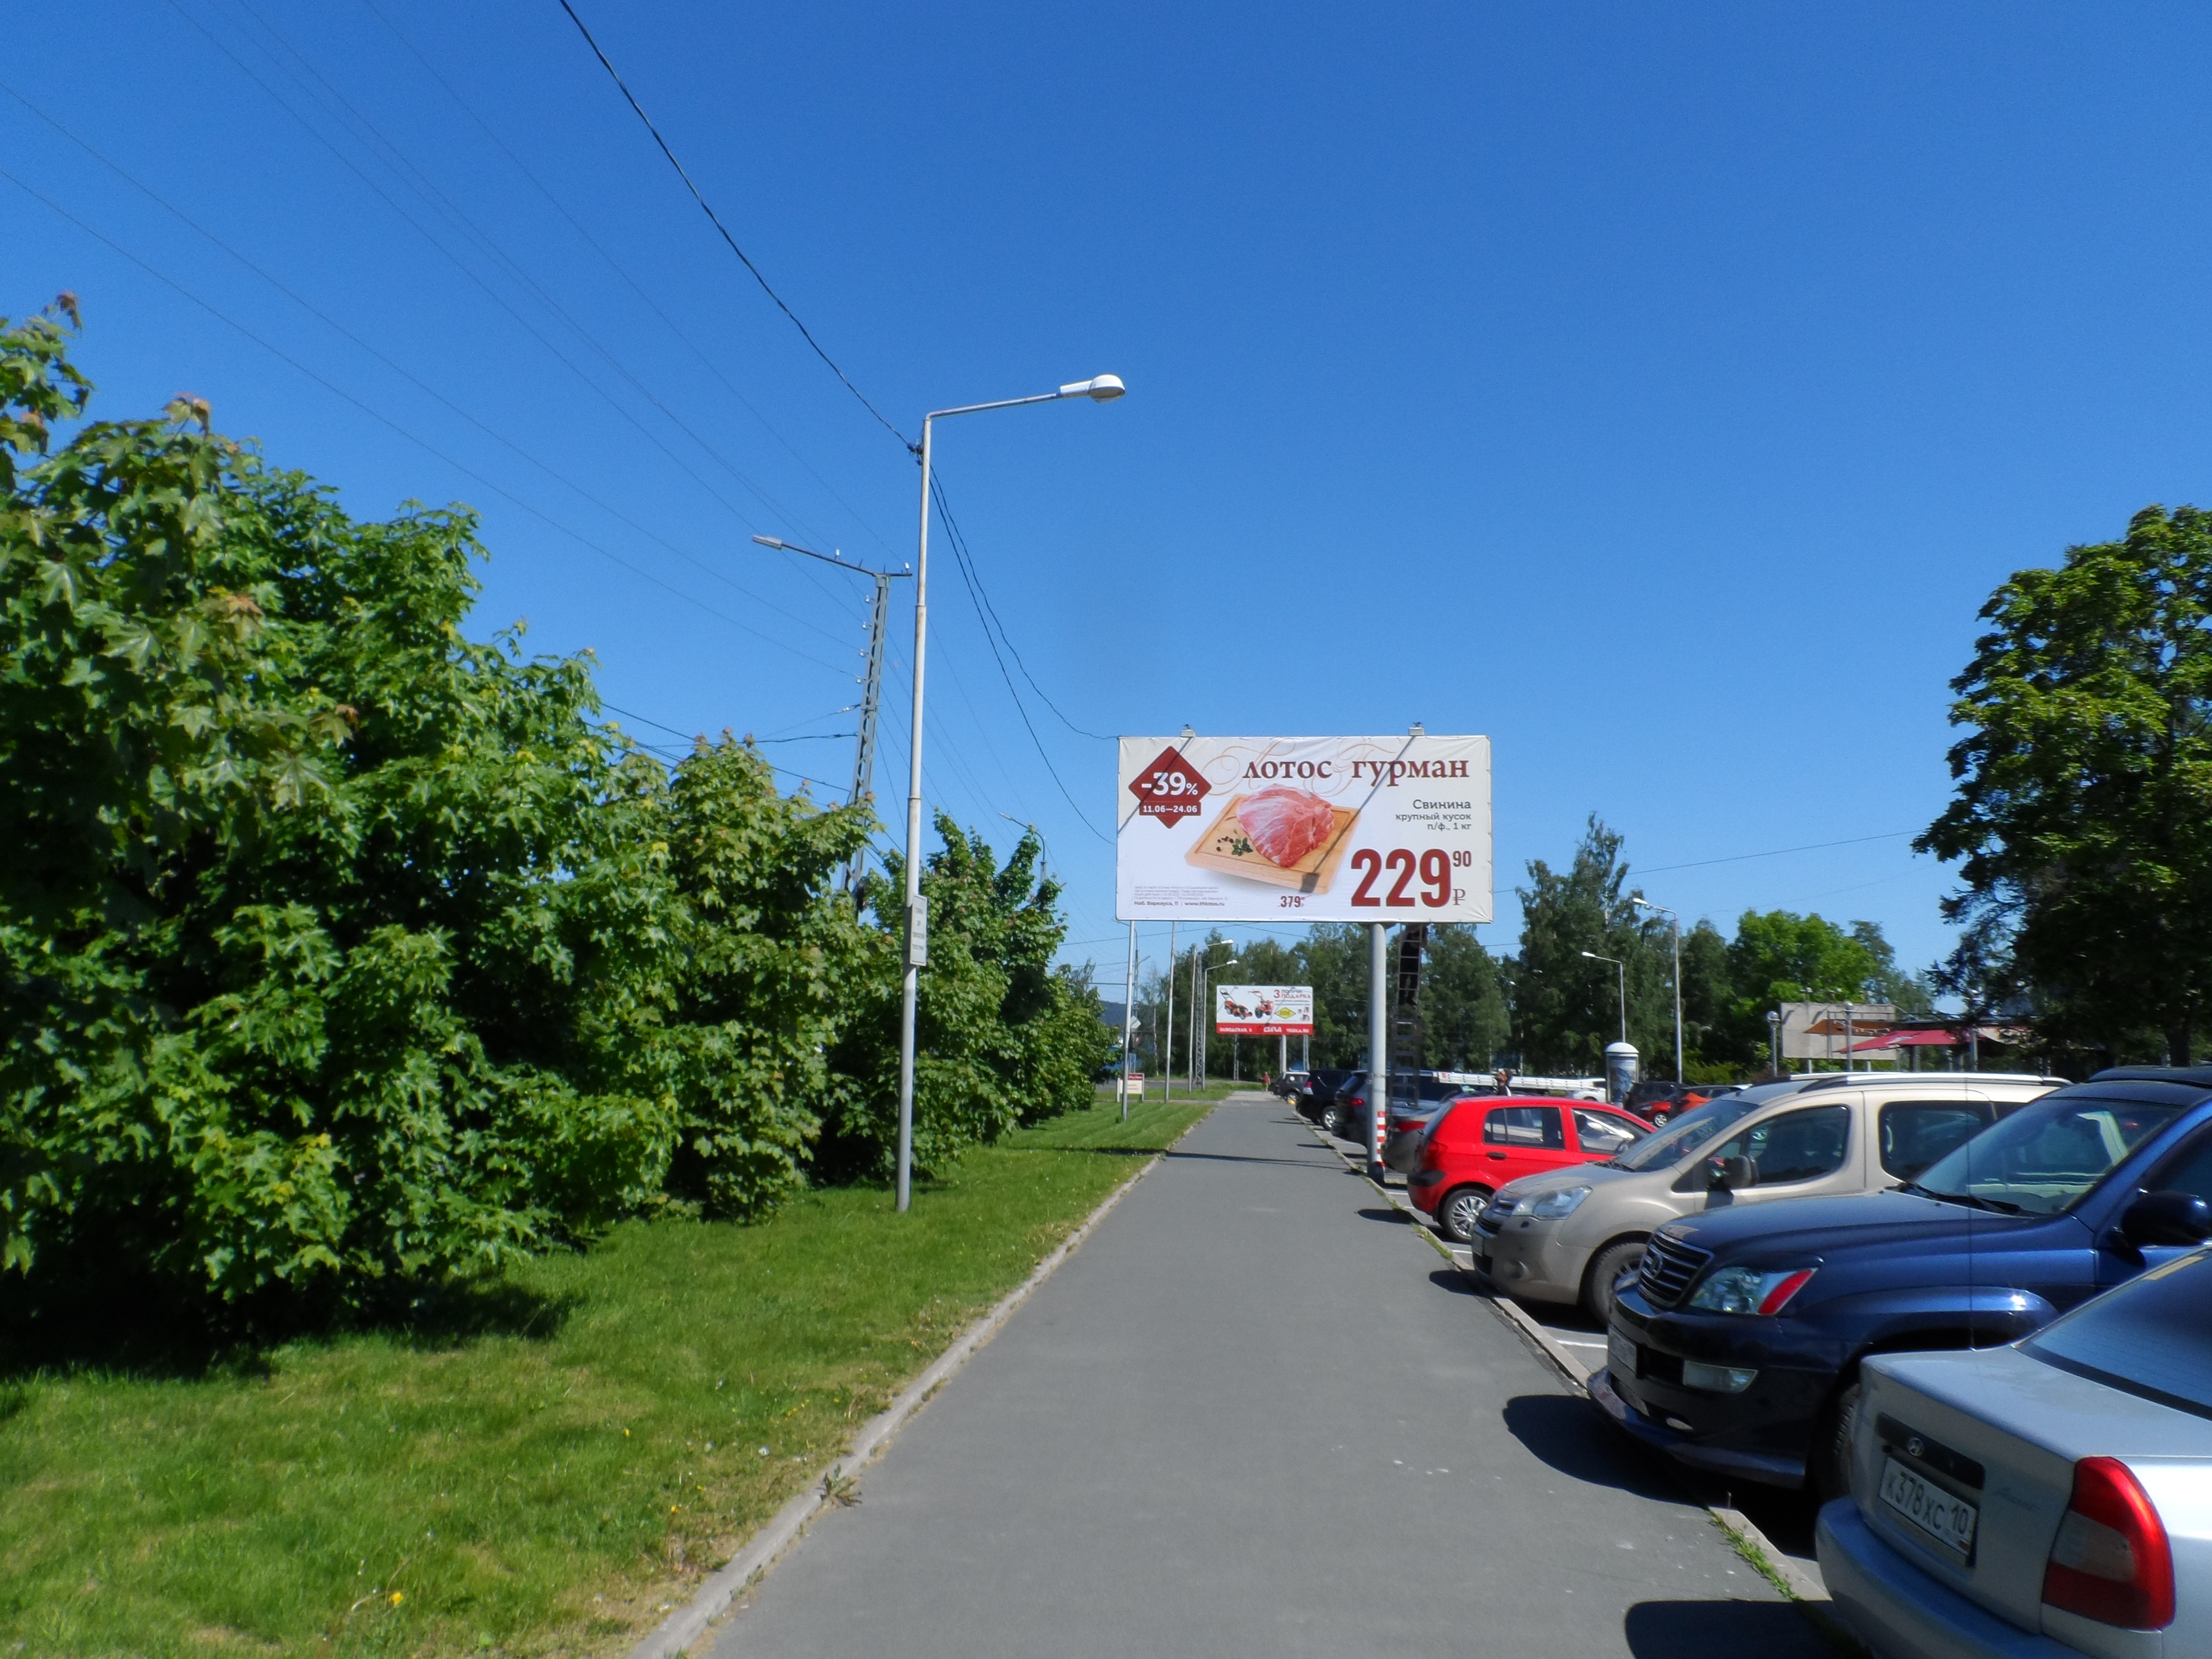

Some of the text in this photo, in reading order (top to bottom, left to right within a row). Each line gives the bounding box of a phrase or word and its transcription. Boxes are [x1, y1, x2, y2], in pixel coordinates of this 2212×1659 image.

[1351, 760, 1469, 786] гурман
[1141, 772, 1198, 796] -39%
[1413, 799, 1472, 809] Свинина
[1395, 813, 1440, 822] крупный
[1351, 848, 1451, 908] 229
[1453, 850, 1472, 867] 90
[1281, 896, 1301, 908] 379
[1273, 989, 1280, 998] 3
